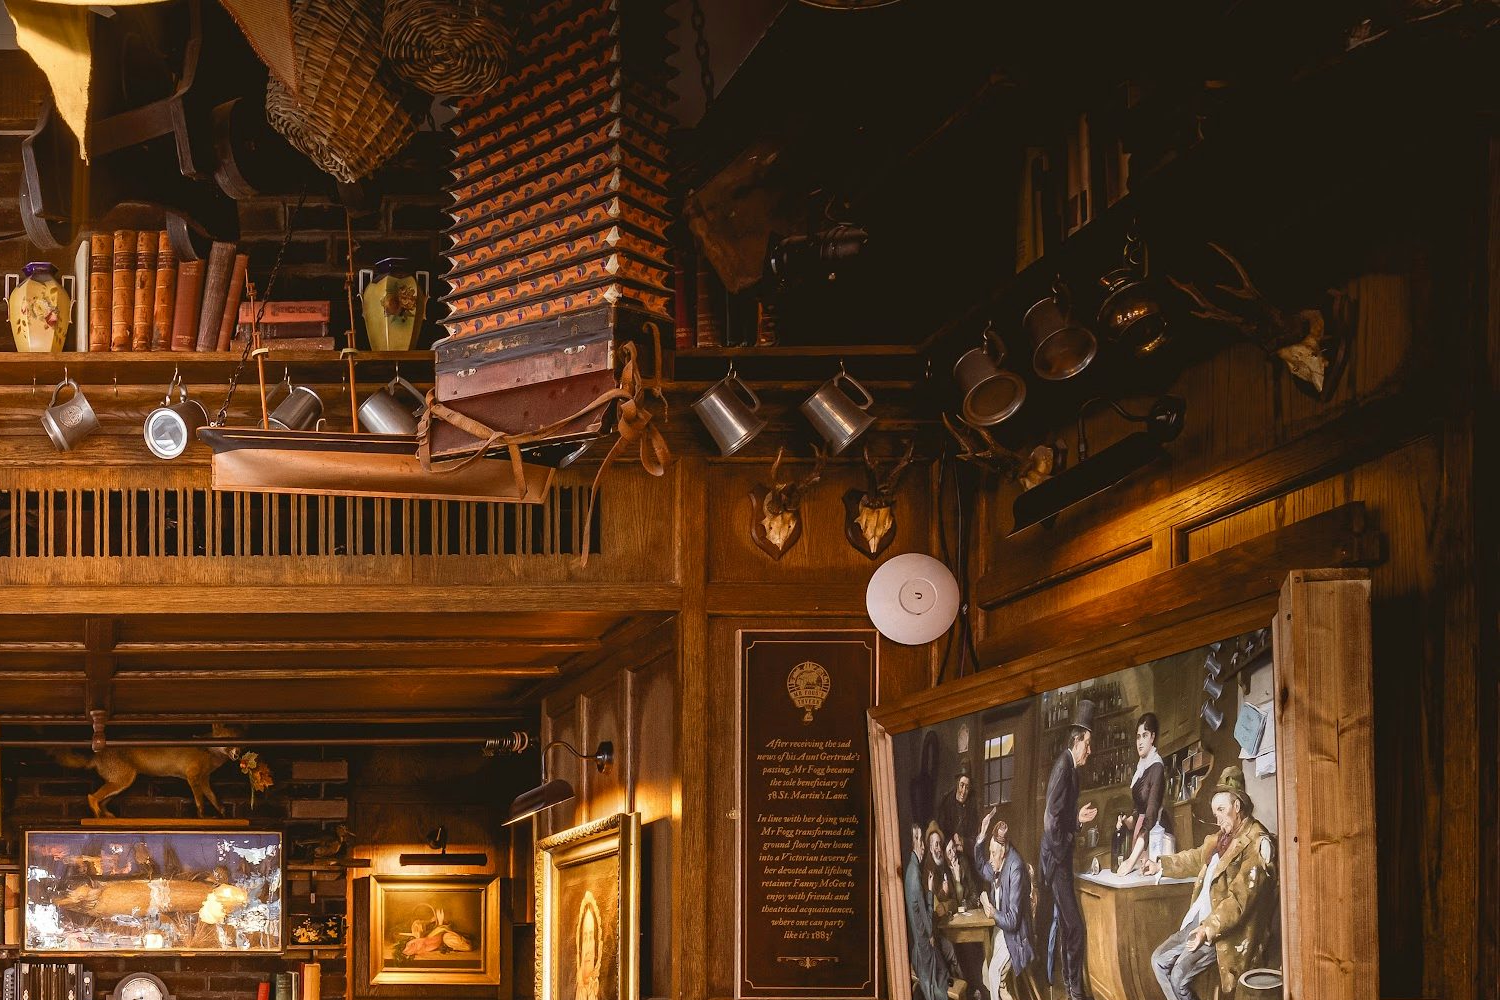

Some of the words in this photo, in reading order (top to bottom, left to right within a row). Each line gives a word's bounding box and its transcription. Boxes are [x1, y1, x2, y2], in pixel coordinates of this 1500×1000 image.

[766, 739, 789, 749] After
[790, 740, 823, 749] receiving
[826, 739, 836, 748] the
[838, 739, 851, 748] sad
[777, 752, 787, 762] of
[762, 766, 791, 775] passing,
[792, 765, 806, 773] Mr
[807, 765, 826, 775] Fogg
[826, 765, 854, 773] became
[770, 778, 781, 786] the
[782, 778, 796, 786] sole
[797, 778, 838, 788] beneficiary
[840, 778, 849, 788] of
[768, 791, 778, 800] 58
[780, 791, 789, 800] St.
[789, 791, 824, 800] Martin's
[825, 791, 848, 800] Lane.
[757, 814, 766, 823] In
[768, 814, 781, 823] line
[783, 814, 801, 823] with
[803, 814, 814, 823] her
[816, 815, 837, 824] dying
[839, 815, 858, 824] wish,
[761, 827, 775, 836] Mr
[776, 827, 794, 837] Fogg
[795, 827, 841, 836] transformed
[843, 827, 855, 836] the
[763, 841, 790, 850] ground
[792, 840, 811, 850] floor
[811, 840, 819, 850] of
[819, 841, 831, 849] her
[833, 841, 853, 849] home
[781, 853, 818, 861] Victorian
[844, 853, 858, 863] for
[824, 866, 852, 876] lifelong
[762, 879, 793, 888] retainer
[793, 879, 818, 889] Fanny
[819, 879, 846, 888] McGee
[848, 879, 854, 888] to
[766, 893, 786, 902] enjoy
[787, 892, 805, 900] with
[806, 892, 833, 902] friends
[834, 892, 850, 900] and
[762, 905, 799, 913] theatrical
[800, 906, 854, 915] acquaintances,
[771, 918, 794, 926] where
[824, 920, 845, 928] party
[784, 931, 798, 939] like
[799, 931, 810, 939] it's
[812, 931, 833, 941] 1883!
